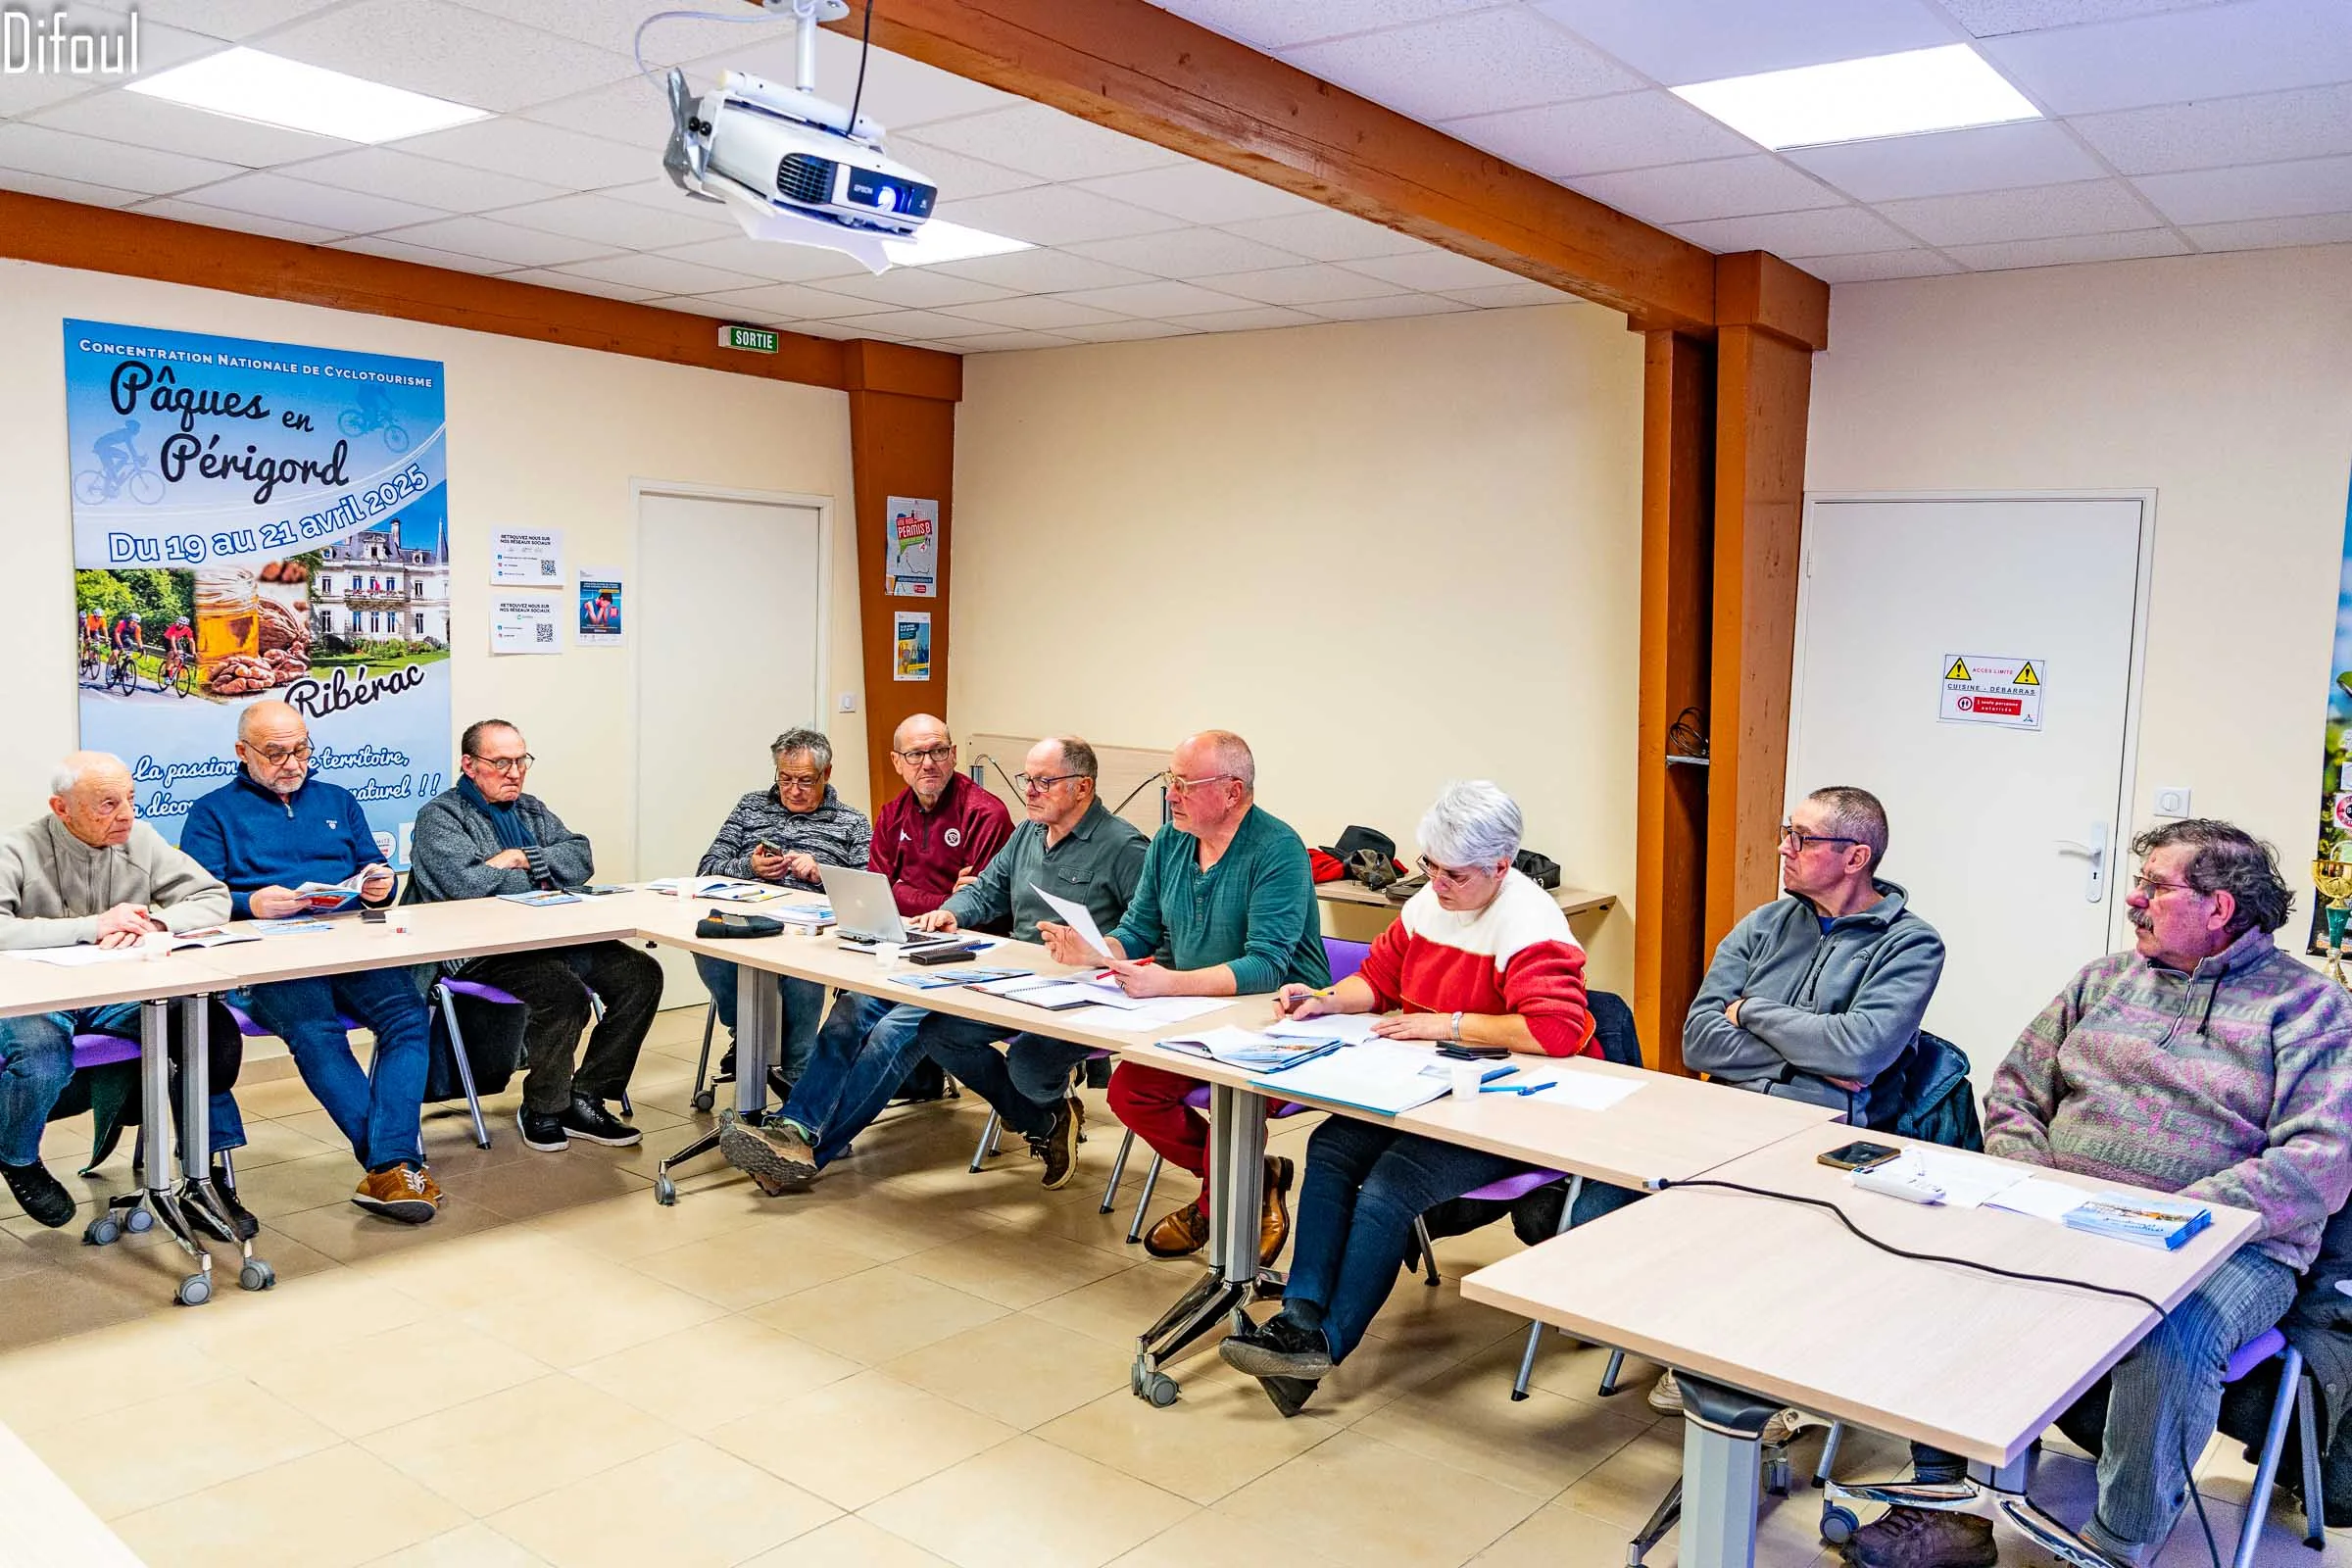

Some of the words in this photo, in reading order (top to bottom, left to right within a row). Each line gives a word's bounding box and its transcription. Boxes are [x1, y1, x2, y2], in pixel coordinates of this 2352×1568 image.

[735, 329, 773, 349] SORTIE
[110, 360, 270, 432] Pâques
[282, 410, 315, 432] en
[161, 432, 350, 505] Périgord
[109, 532, 158, 563] Du
[166, 534, 207, 564] 19
[213, 528, 255, 556] au
[260, 520, 297, 549] 21
[300, 495, 367, 537] avril
[362, 463, 428, 515] 2025
[898, 522, 925, 539] PERMIS
[284, 666, 425, 718] Ribérac
[1947, 683, 1980, 692] CUISINE
[163, 756, 238, 789] passion
